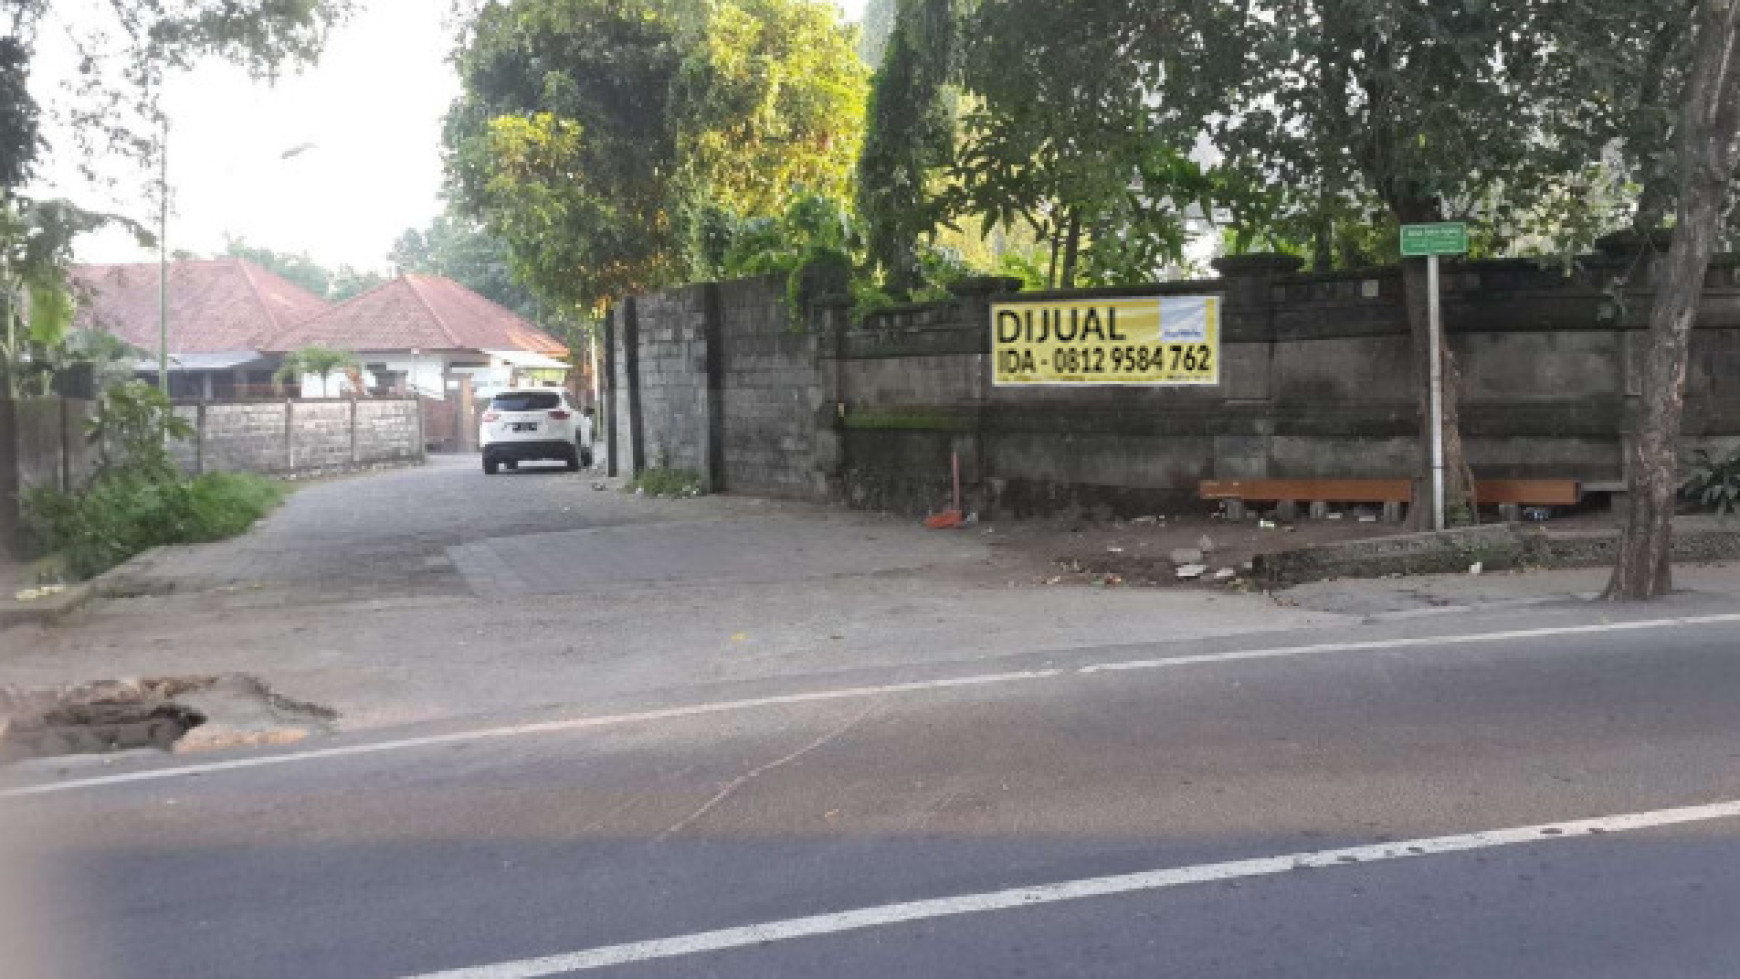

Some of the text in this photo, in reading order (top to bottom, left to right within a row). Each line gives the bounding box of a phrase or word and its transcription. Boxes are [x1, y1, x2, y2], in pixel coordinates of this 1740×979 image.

[997, 307, 1126, 343] DIJUAL
[998, 348, 1036, 373] IDA
[1053, 347, 1105, 373] 0812
[1111, 345, 1163, 373] 9584
[1169, 345, 1212, 371] 762
